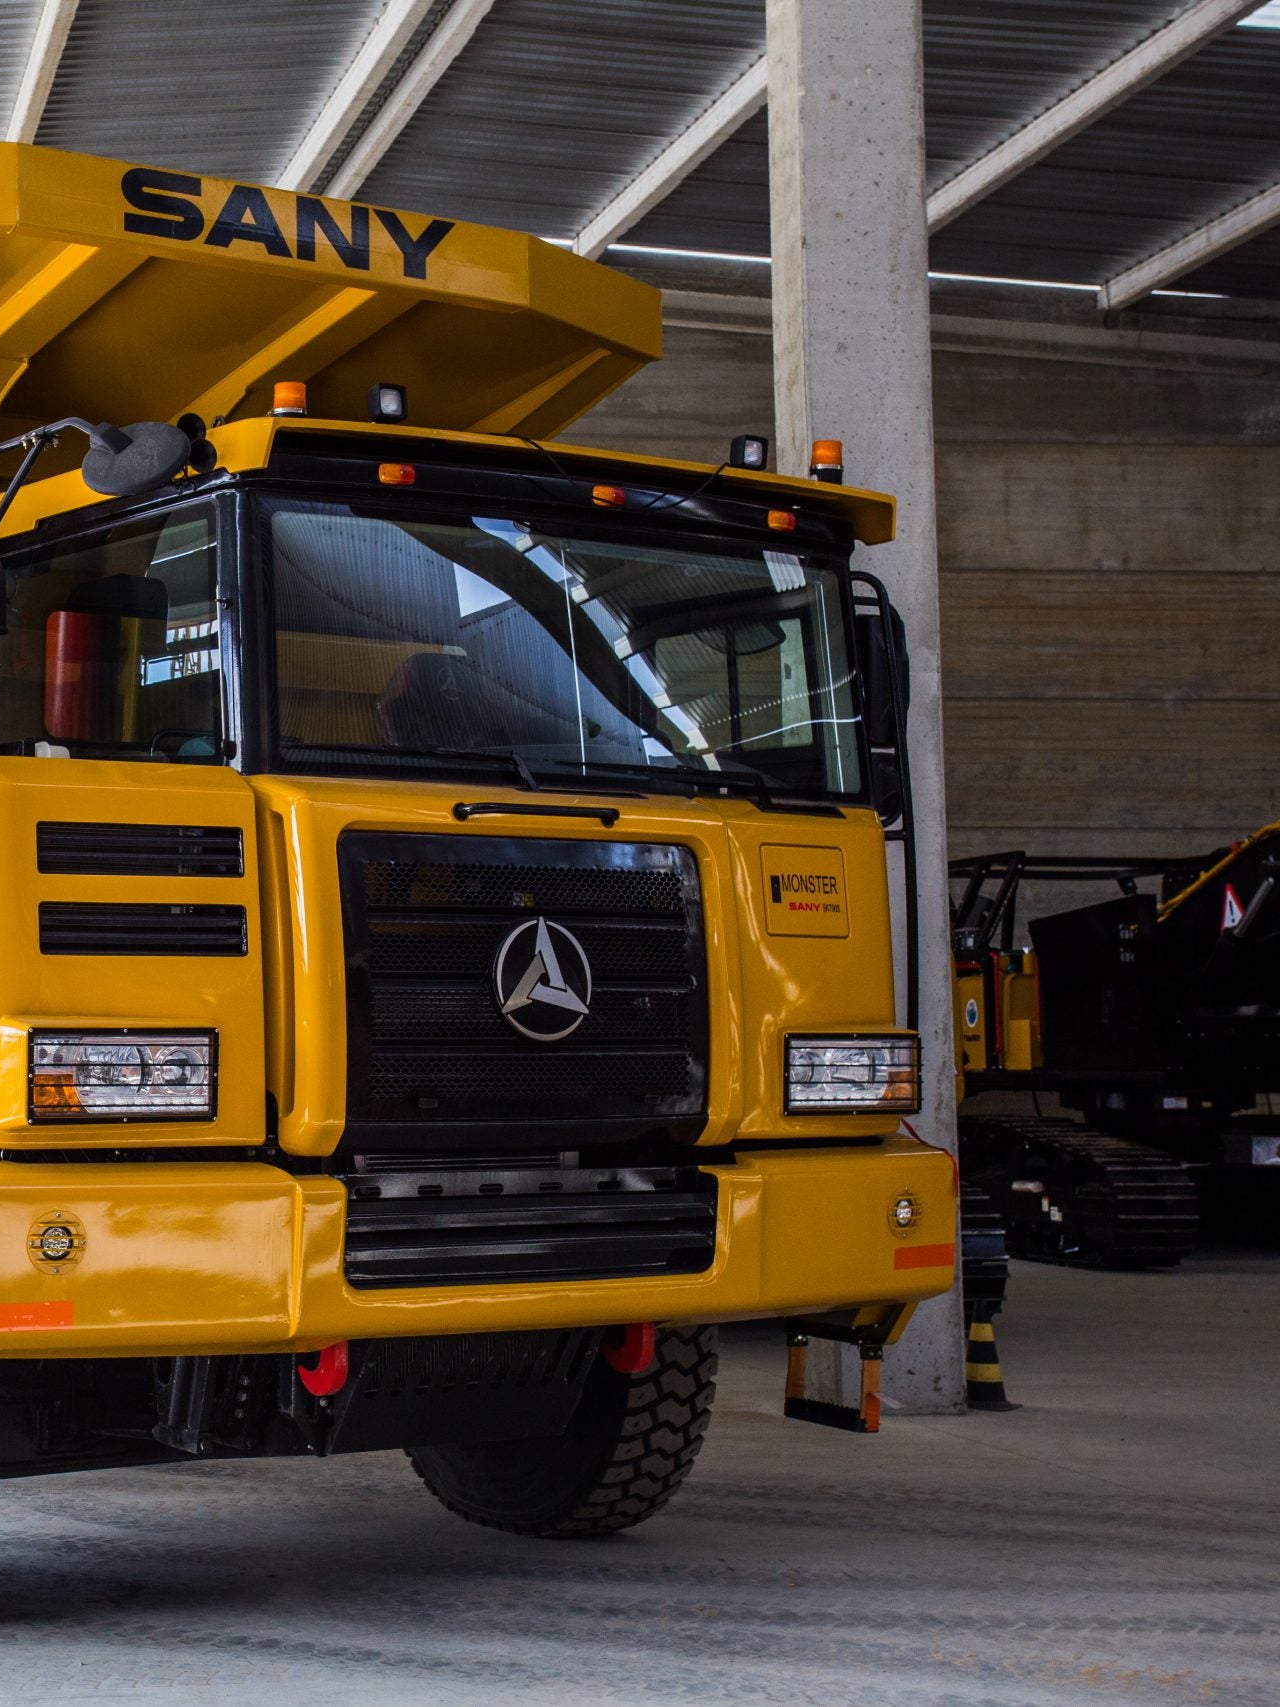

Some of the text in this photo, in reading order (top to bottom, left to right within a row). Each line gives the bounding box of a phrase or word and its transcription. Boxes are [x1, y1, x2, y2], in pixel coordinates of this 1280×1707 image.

[121, 168, 456, 280] SANY
[781, 874, 838, 895] MONSTER
[788, 902, 821, 912] SANY
